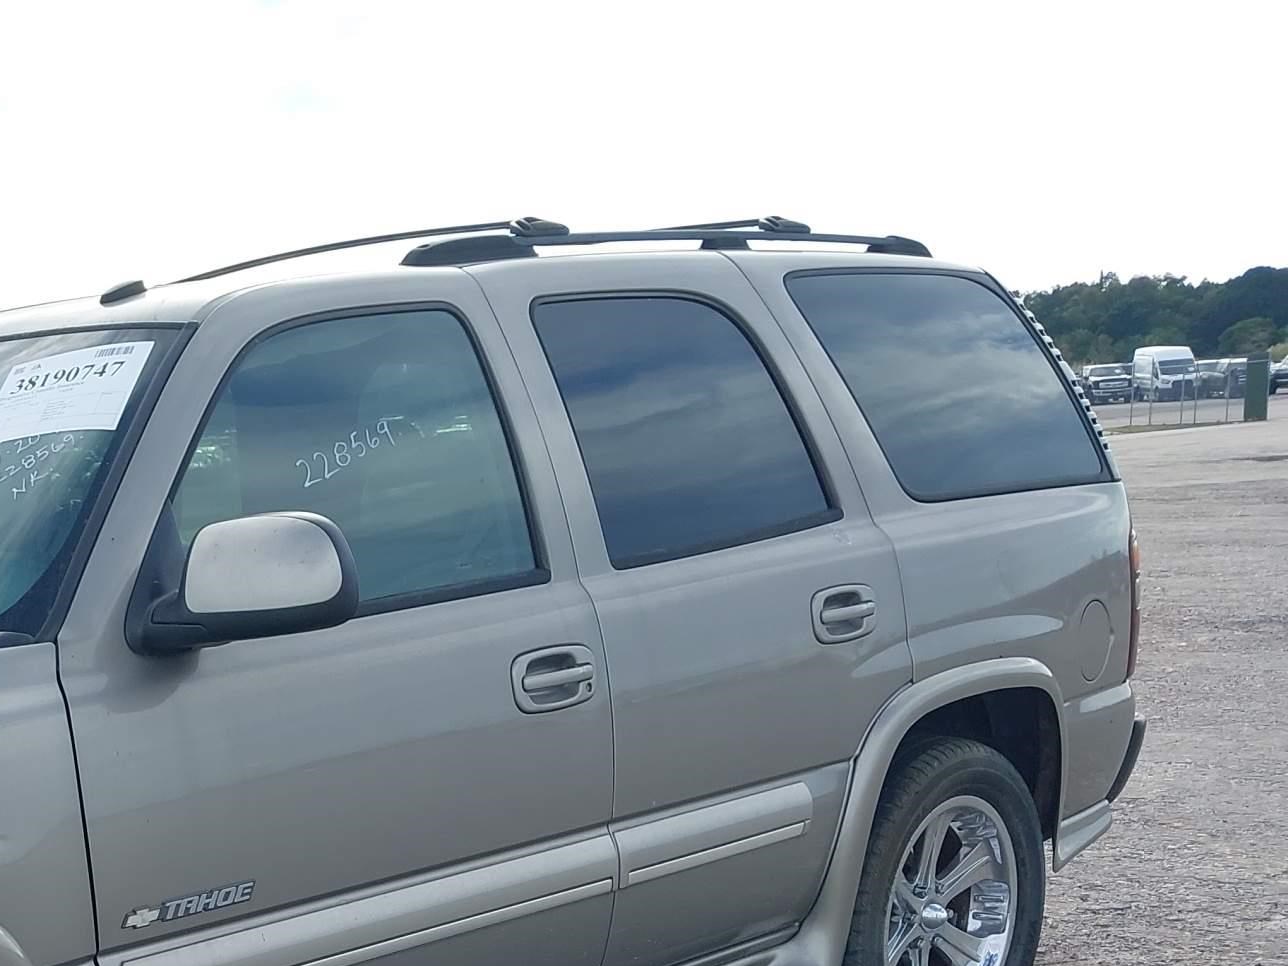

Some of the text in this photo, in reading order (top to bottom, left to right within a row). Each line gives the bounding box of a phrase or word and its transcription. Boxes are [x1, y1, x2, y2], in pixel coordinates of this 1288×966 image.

[9, 360, 126, 395] 38190747
[295, 418, 395, 487] 228569
[165, 881, 254, 920] TAHOE
